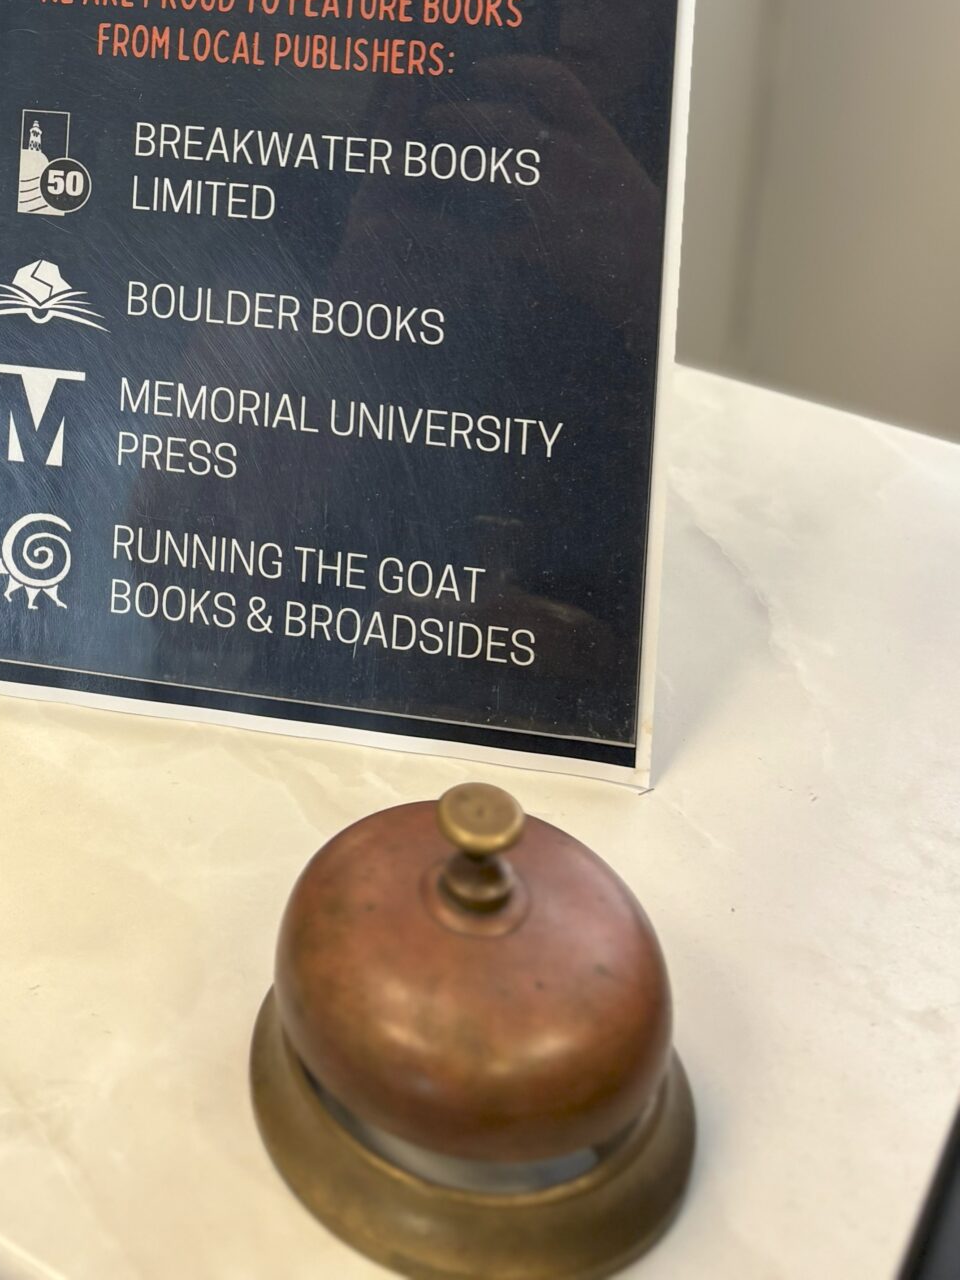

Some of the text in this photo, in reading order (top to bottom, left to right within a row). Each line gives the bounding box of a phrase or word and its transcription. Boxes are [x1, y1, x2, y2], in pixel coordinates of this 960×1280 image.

[97, 22, 456, 77] FROM LOCAL PUBLISHERS:
[46, 169, 85, 197] 50
[134, 121, 541, 186] BREAKWATER BOOKS
[132, 175, 276, 220] LIMITED
[126, 280, 445, 346] BOULDER BOOKS
[120, 376, 564, 458] MEMORIAL UNIVERSITY
[117, 430, 237, 479] PRESS
[112, 524, 486, 603] RUNNING THE GOAT
[110, 578, 535, 666] BOOKS & BROADSIDES
